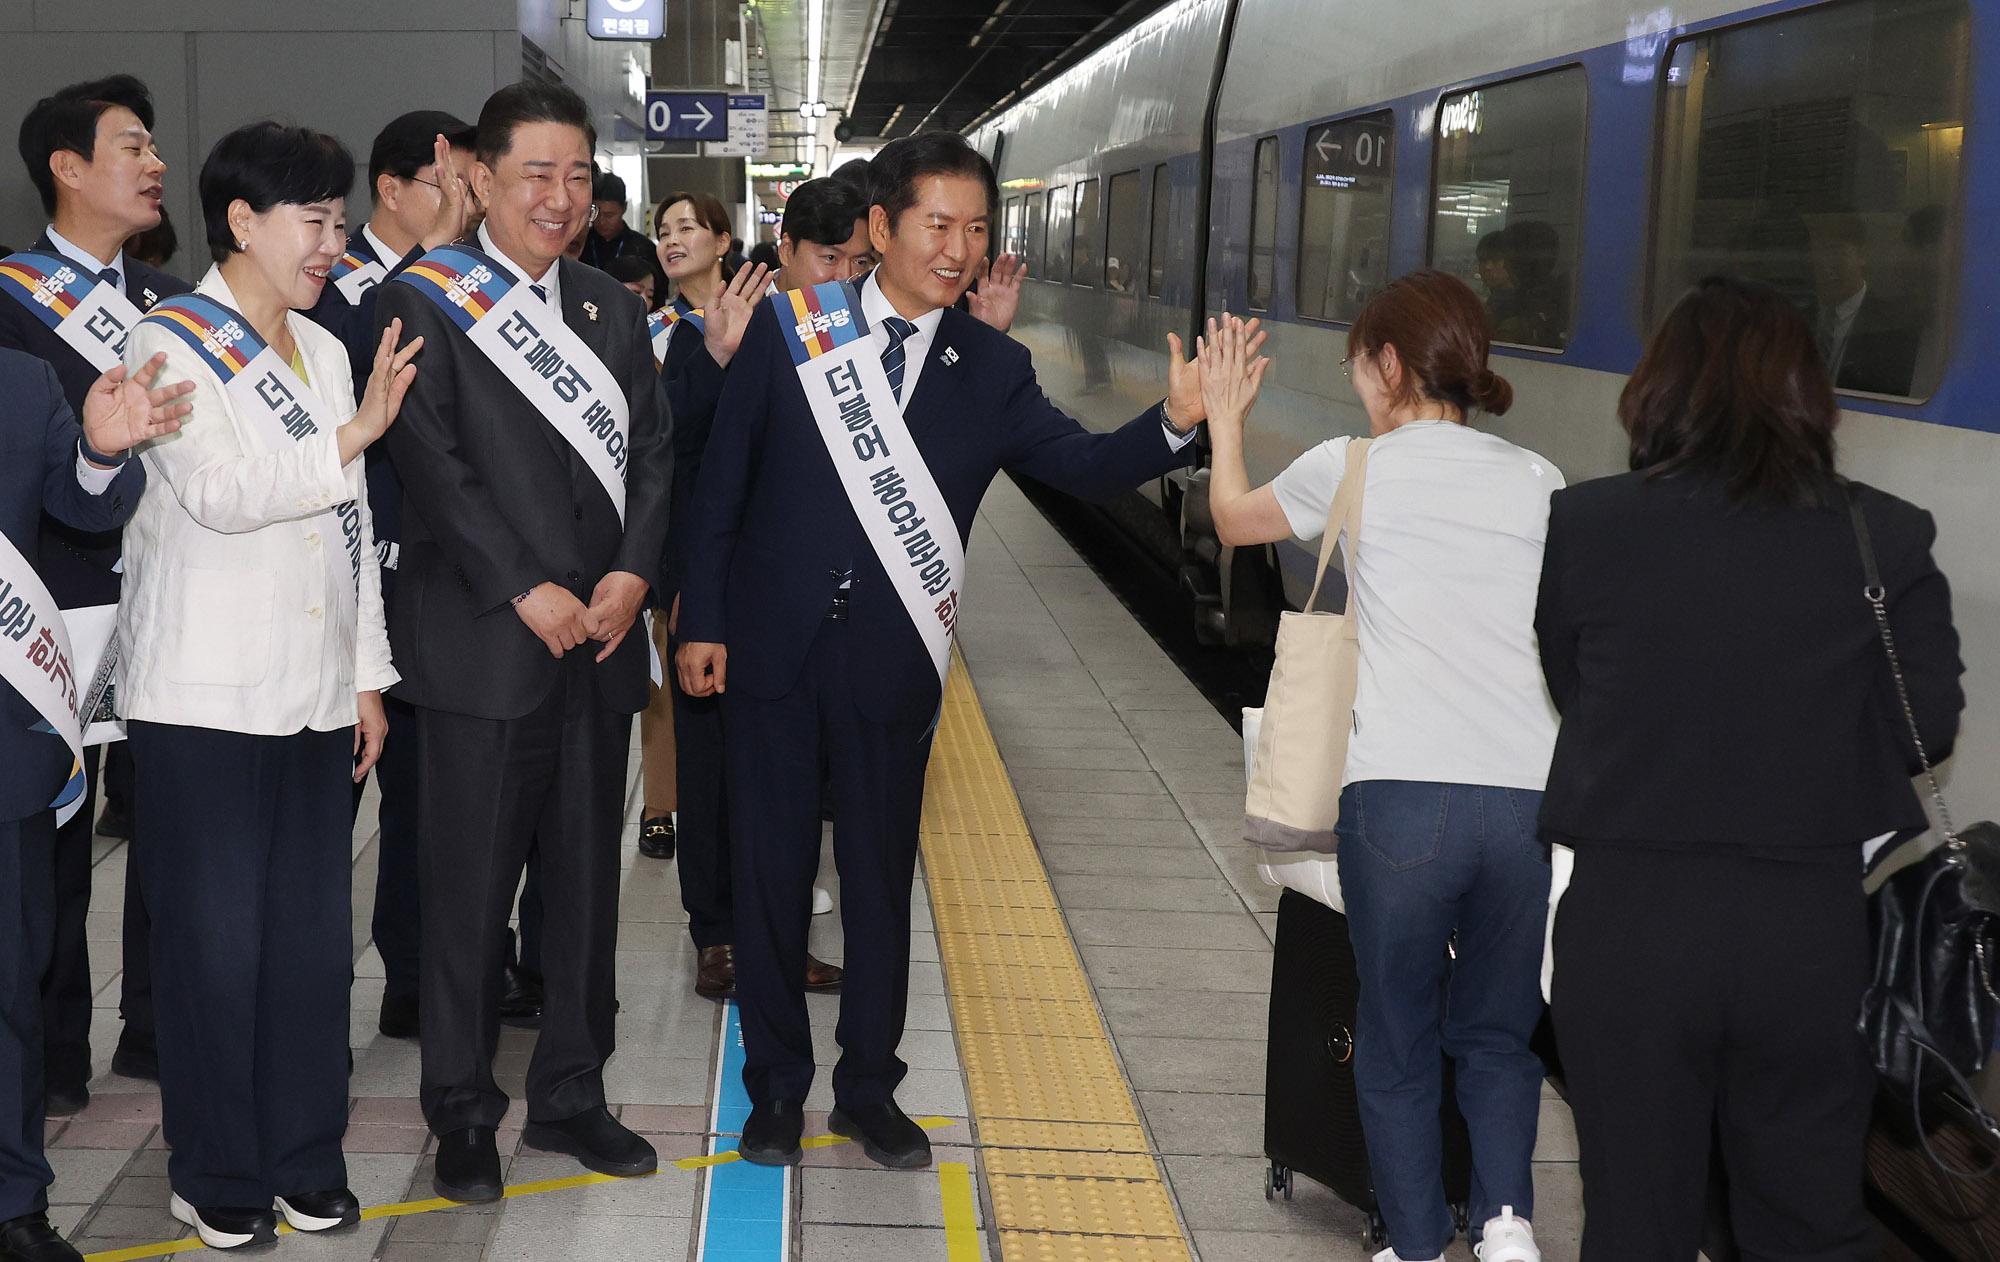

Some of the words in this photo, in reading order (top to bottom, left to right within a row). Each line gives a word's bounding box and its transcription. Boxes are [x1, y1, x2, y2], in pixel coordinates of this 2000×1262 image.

[32, 266, 77, 308] 민주당
[445, 264, 493, 308] 민주당
[202, 319, 245, 359] 민주당
[795, 308, 850, 343] 민주당
[497, 309, 592, 403] 더불어
[824, 358, 890, 463] 더불어
[868, 464, 951, 598] 풍요로운
